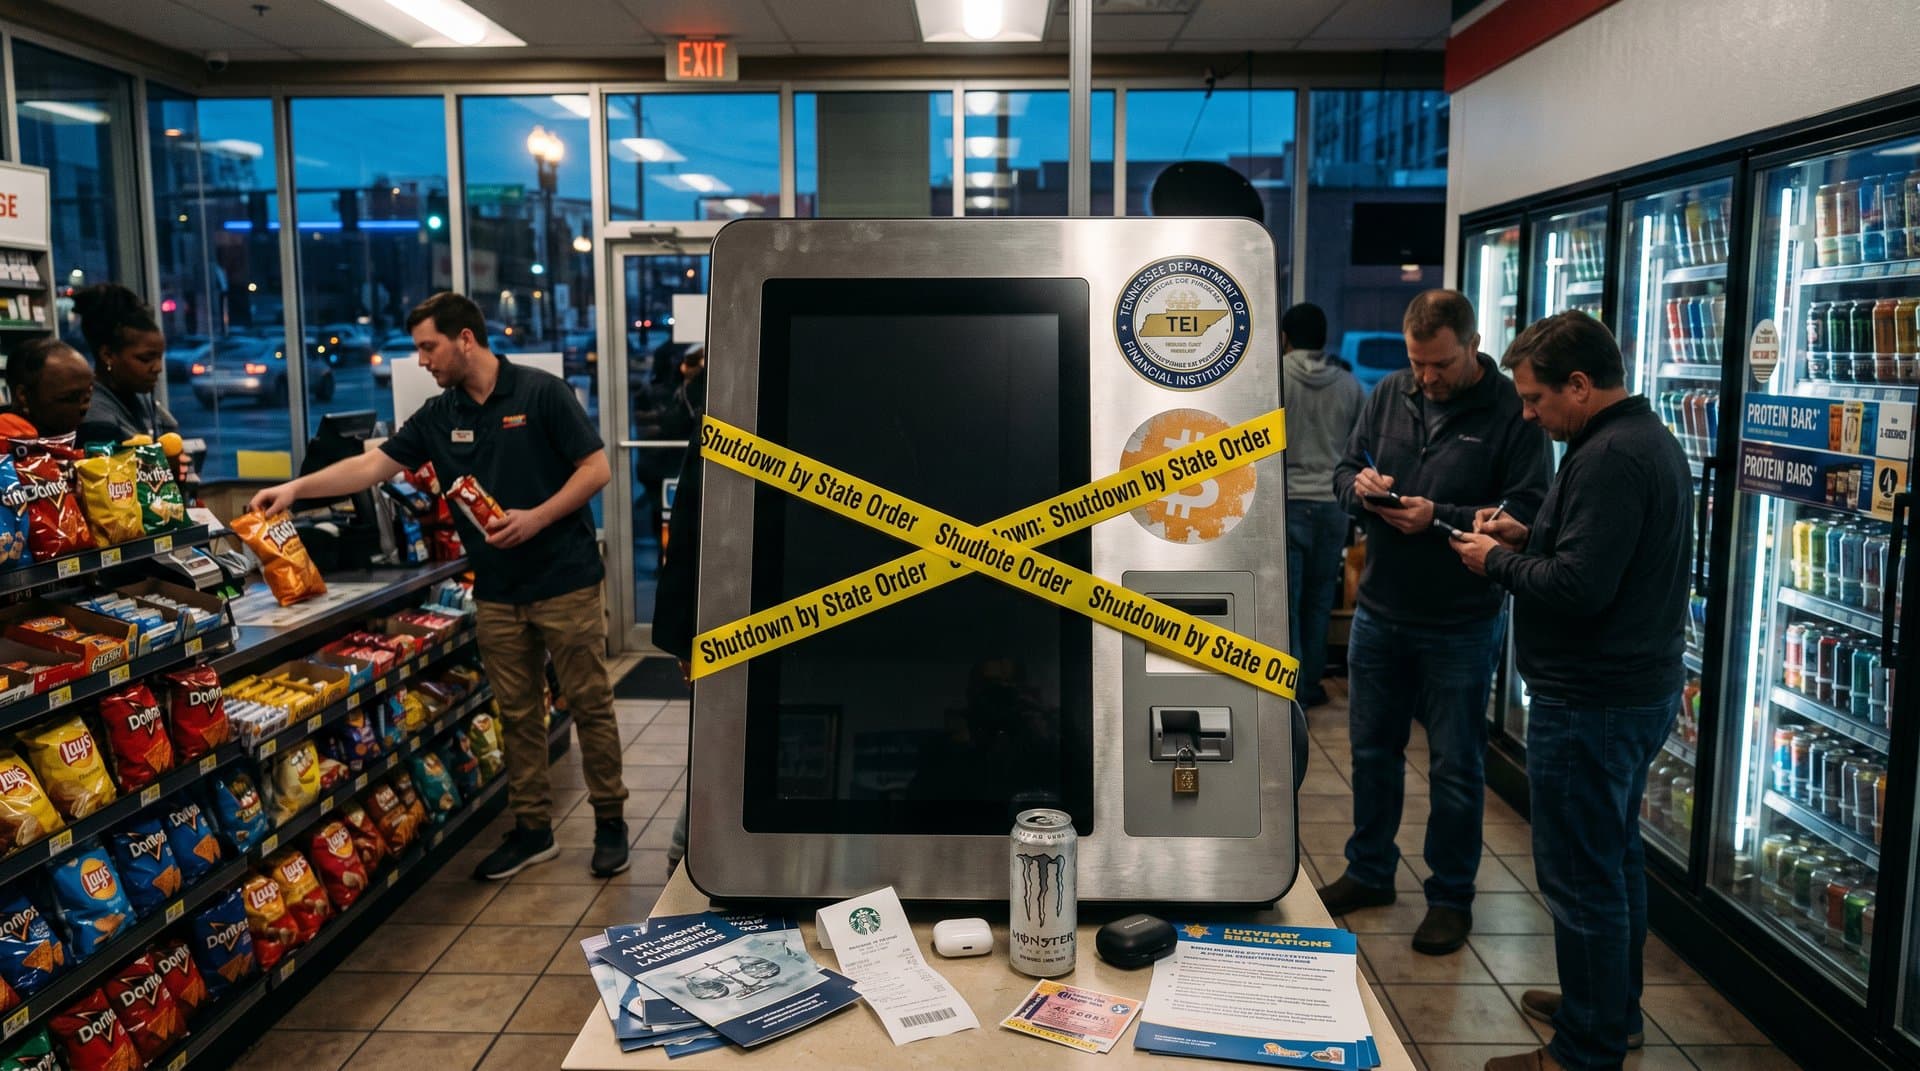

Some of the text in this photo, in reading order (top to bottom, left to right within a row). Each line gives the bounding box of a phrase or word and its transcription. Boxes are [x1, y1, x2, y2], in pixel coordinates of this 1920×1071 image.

[678, 42, 726, 77] EXIT
[1120, 265, 1167, 316] TENNESSEE
[1168, 261, 1239, 299] DEPARTMENT
[1233, 301, 1246, 316] OF
[1166, 316, 1198, 332] TEI
[1124, 341, 1173, 384] FINANCIAL
[1747, 403, 1789, 428] PROTEIN
[700, 424, 919, 533] Shutdown by State Order
[1048, 476, 1141, 528] Shutdown
[1141, 468, 1167, 491] by
[1168, 447, 1218, 481] State
[1219, 425, 1272, 461] Order
[1743, 455, 1784, 482] PROTEIN
[1018, 556, 1073, 596] Order
[700, 561, 928, 664] Shutdown by State Order
[1088, 584, 1182, 643] Shutdown
[1184, 624, 1210, 656] by
[1211, 635, 1262, 674] State
[1012, 928, 1075, 948] MONSTER
